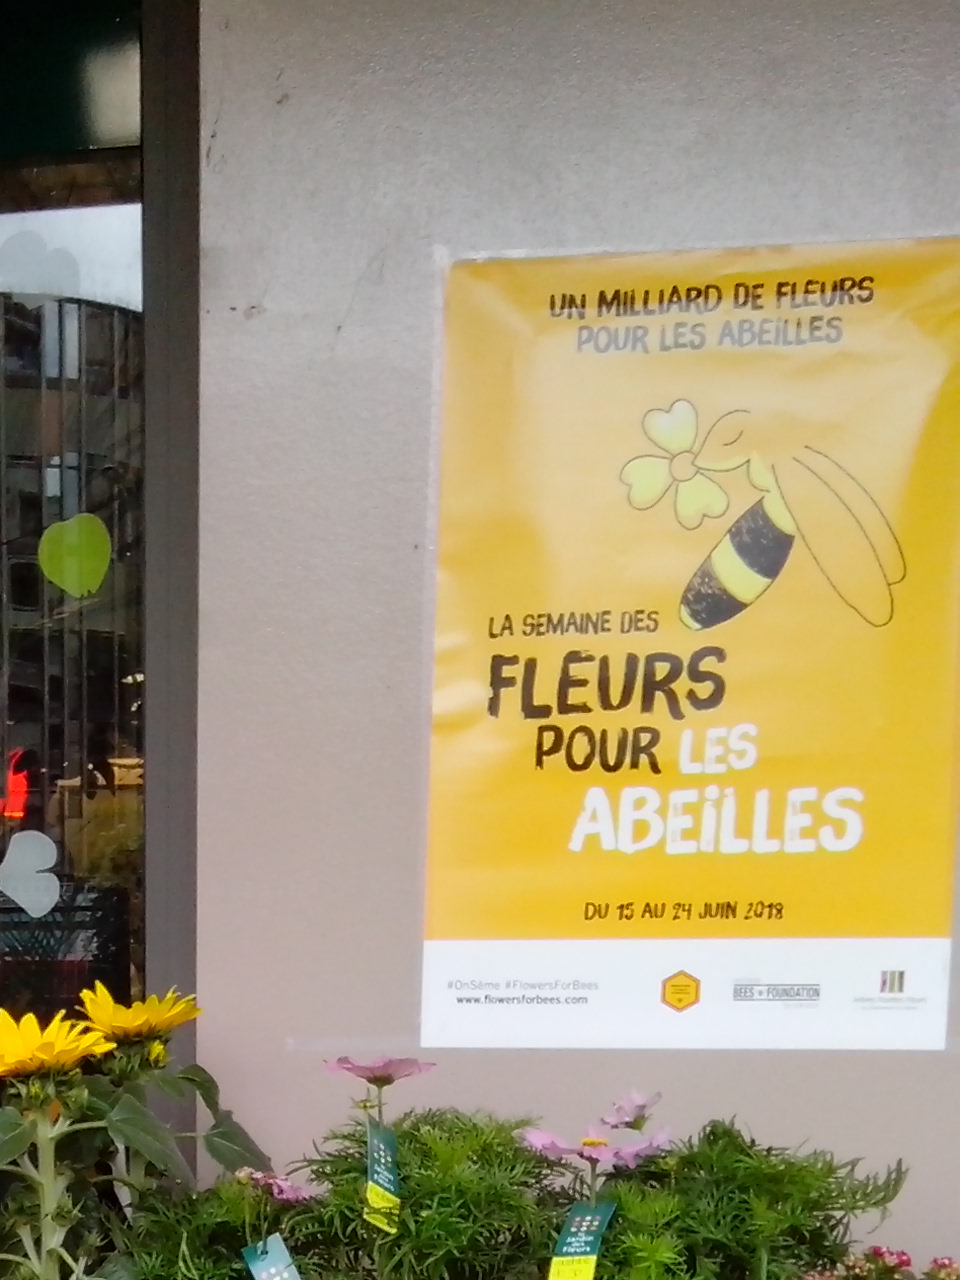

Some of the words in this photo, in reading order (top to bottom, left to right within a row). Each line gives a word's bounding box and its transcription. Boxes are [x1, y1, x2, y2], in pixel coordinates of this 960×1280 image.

[550, 293, 587, 320] UN
[597, 284, 723, 318] MILLIARD
[733, 282, 765, 310] DE
[776, 276, 875, 309] FLEURS
[577, 325, 650, 354] POUR
[659, 321, 707, 352] LES
[488, 613, 515, 639] LA
[522, 609, 612, 637] SEMAINE
[620, 609, 660, 633] DES
[487, 646, 728, 720] FLEURS
[535, 725, 662, 775] POUR
[678, 723, 759, 775] LES
[584, 902, 609, 921] DU
[616, 902, 635, 920] 15
[641, 902, 666, 920] AU
[672, 902, 693, 921] 24
[698, 901, 738, 921] JUIN
[744, 902, 785, 921] 2018
[456, 994, 588, 1006] www.flowersforbees.com
[505, 979, 600, 991] #FlowersForBees
[733, 987, 755, 998] BEES
[767, 987, 821, 998] FOUNDATION
